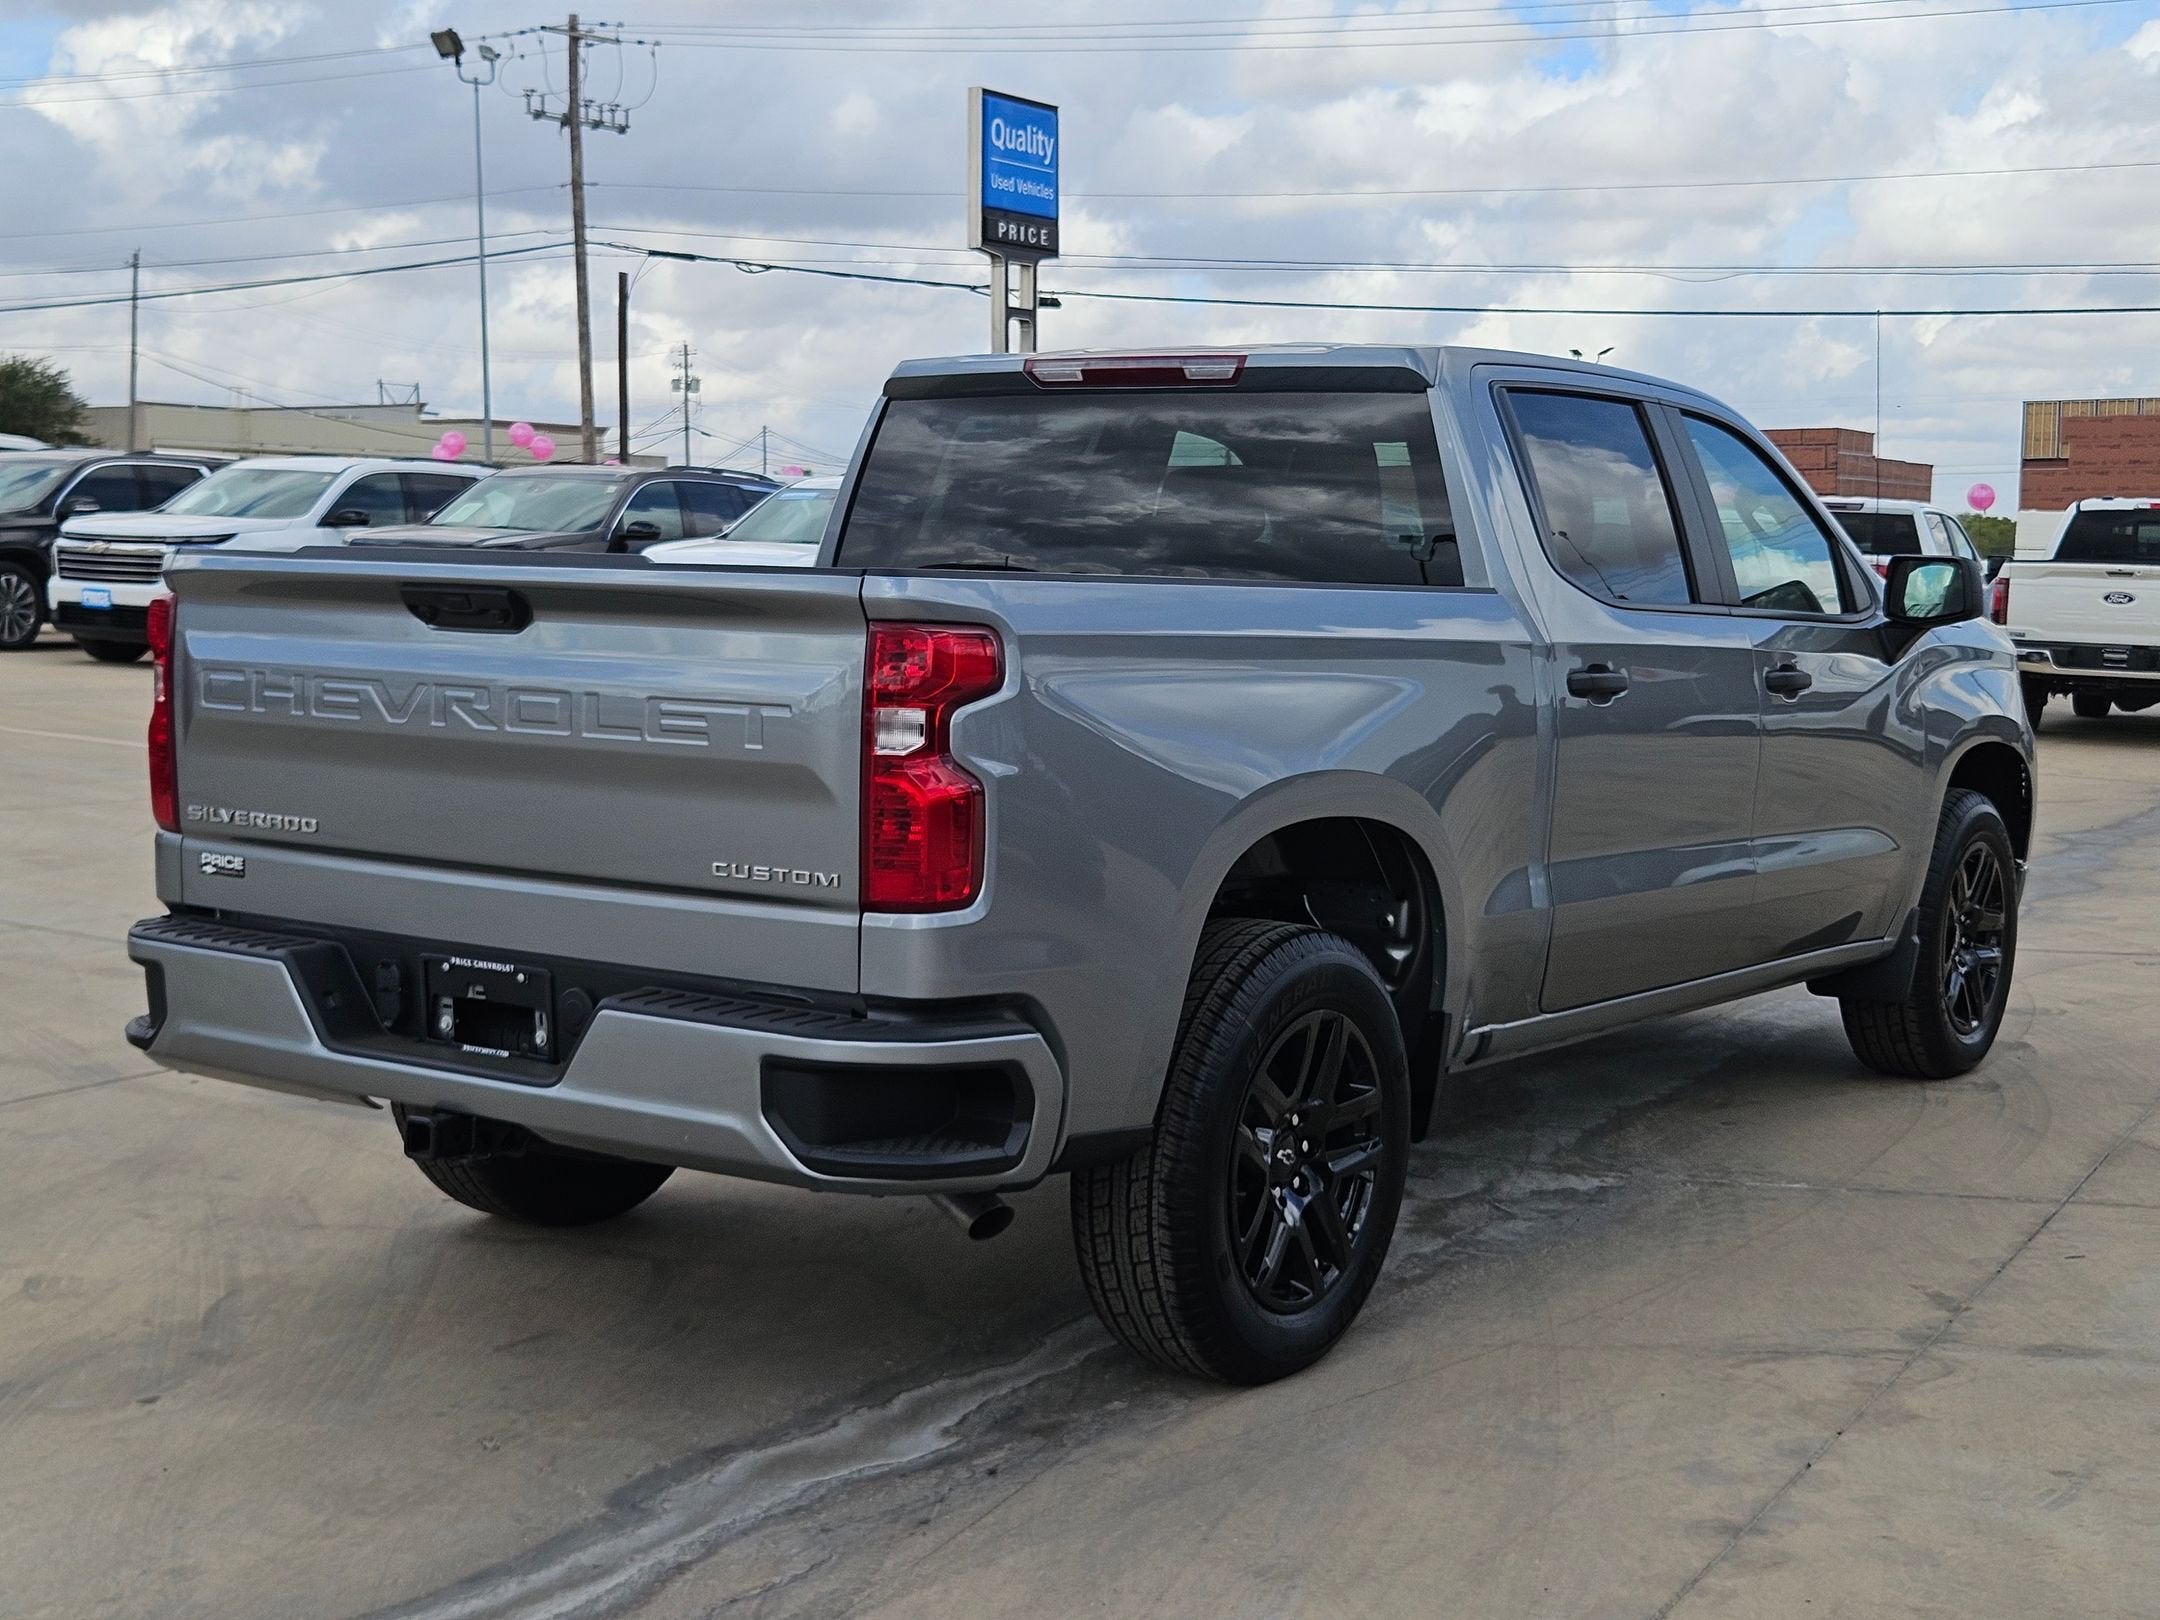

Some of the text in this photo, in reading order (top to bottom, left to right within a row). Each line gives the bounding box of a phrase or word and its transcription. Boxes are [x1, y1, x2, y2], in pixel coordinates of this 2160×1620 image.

[991, 118, 1054, 165] Quality
[991, 173, 1054, 200] Used Vehicles
[998, 222, 1049, 245] PRICE
[2106, 593, 2131, 604] Ford
[199, 667, 793, 751] CHEVROLET
[186, 804, 319, 833] SILVERADO
[201, 852, 244, 870] PRICE
[712, 862, 841, 888] CUSTOM
[450, 956, 472, 967] PRICE
[473, 960, 515, 973] CHEVROLET
